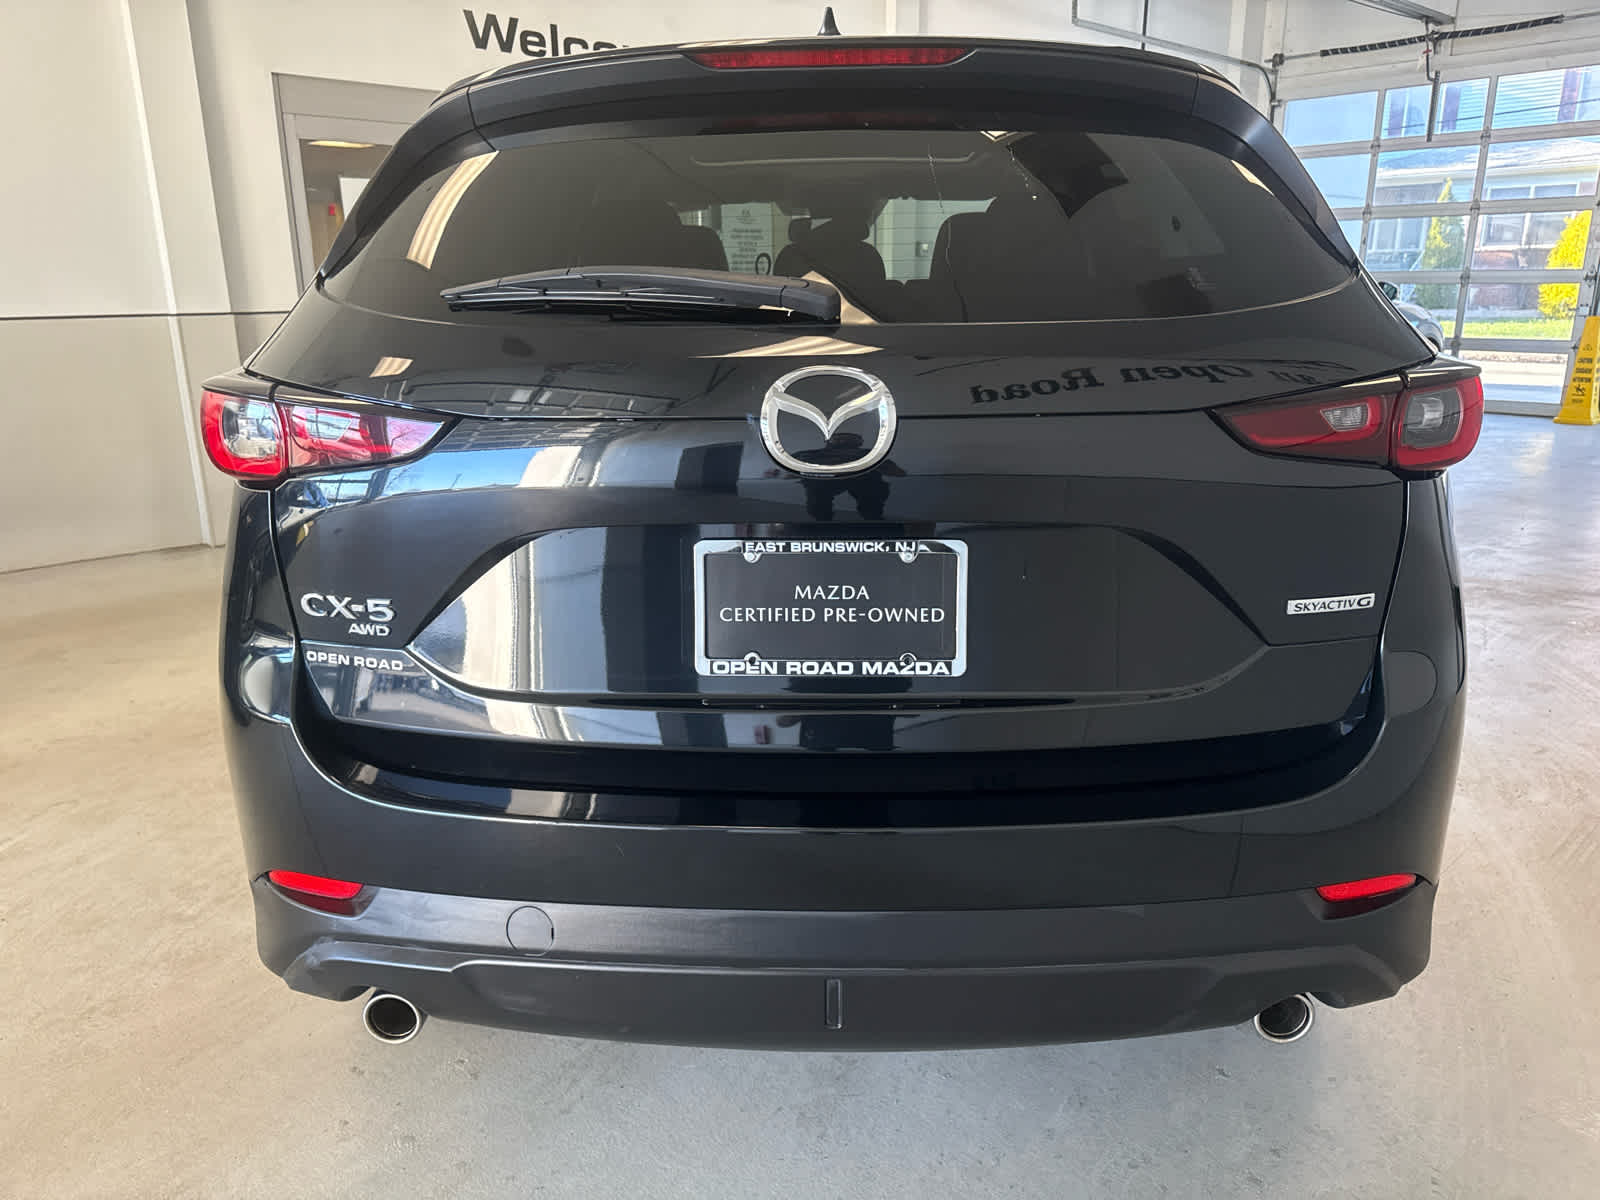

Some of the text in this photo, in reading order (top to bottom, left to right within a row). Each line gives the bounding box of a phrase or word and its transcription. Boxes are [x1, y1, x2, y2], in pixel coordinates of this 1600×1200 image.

[463, 9, 629, 57] Welc
[744, 541, 916, 554] EAST BRUNSWICK, NJ
[794, 585, 870, 600] MAZDA
[300, 592, 395, 623] CX-5
[719, 607, 945, 622] CERTIFIED PRE-OWNED
[348, 623, 391, 636] AWD
[306, 650, 403, 671] OPEN ROAD
[712, 660, 777, 675] OPEN
[786, 661, 854, 675] ROAD
